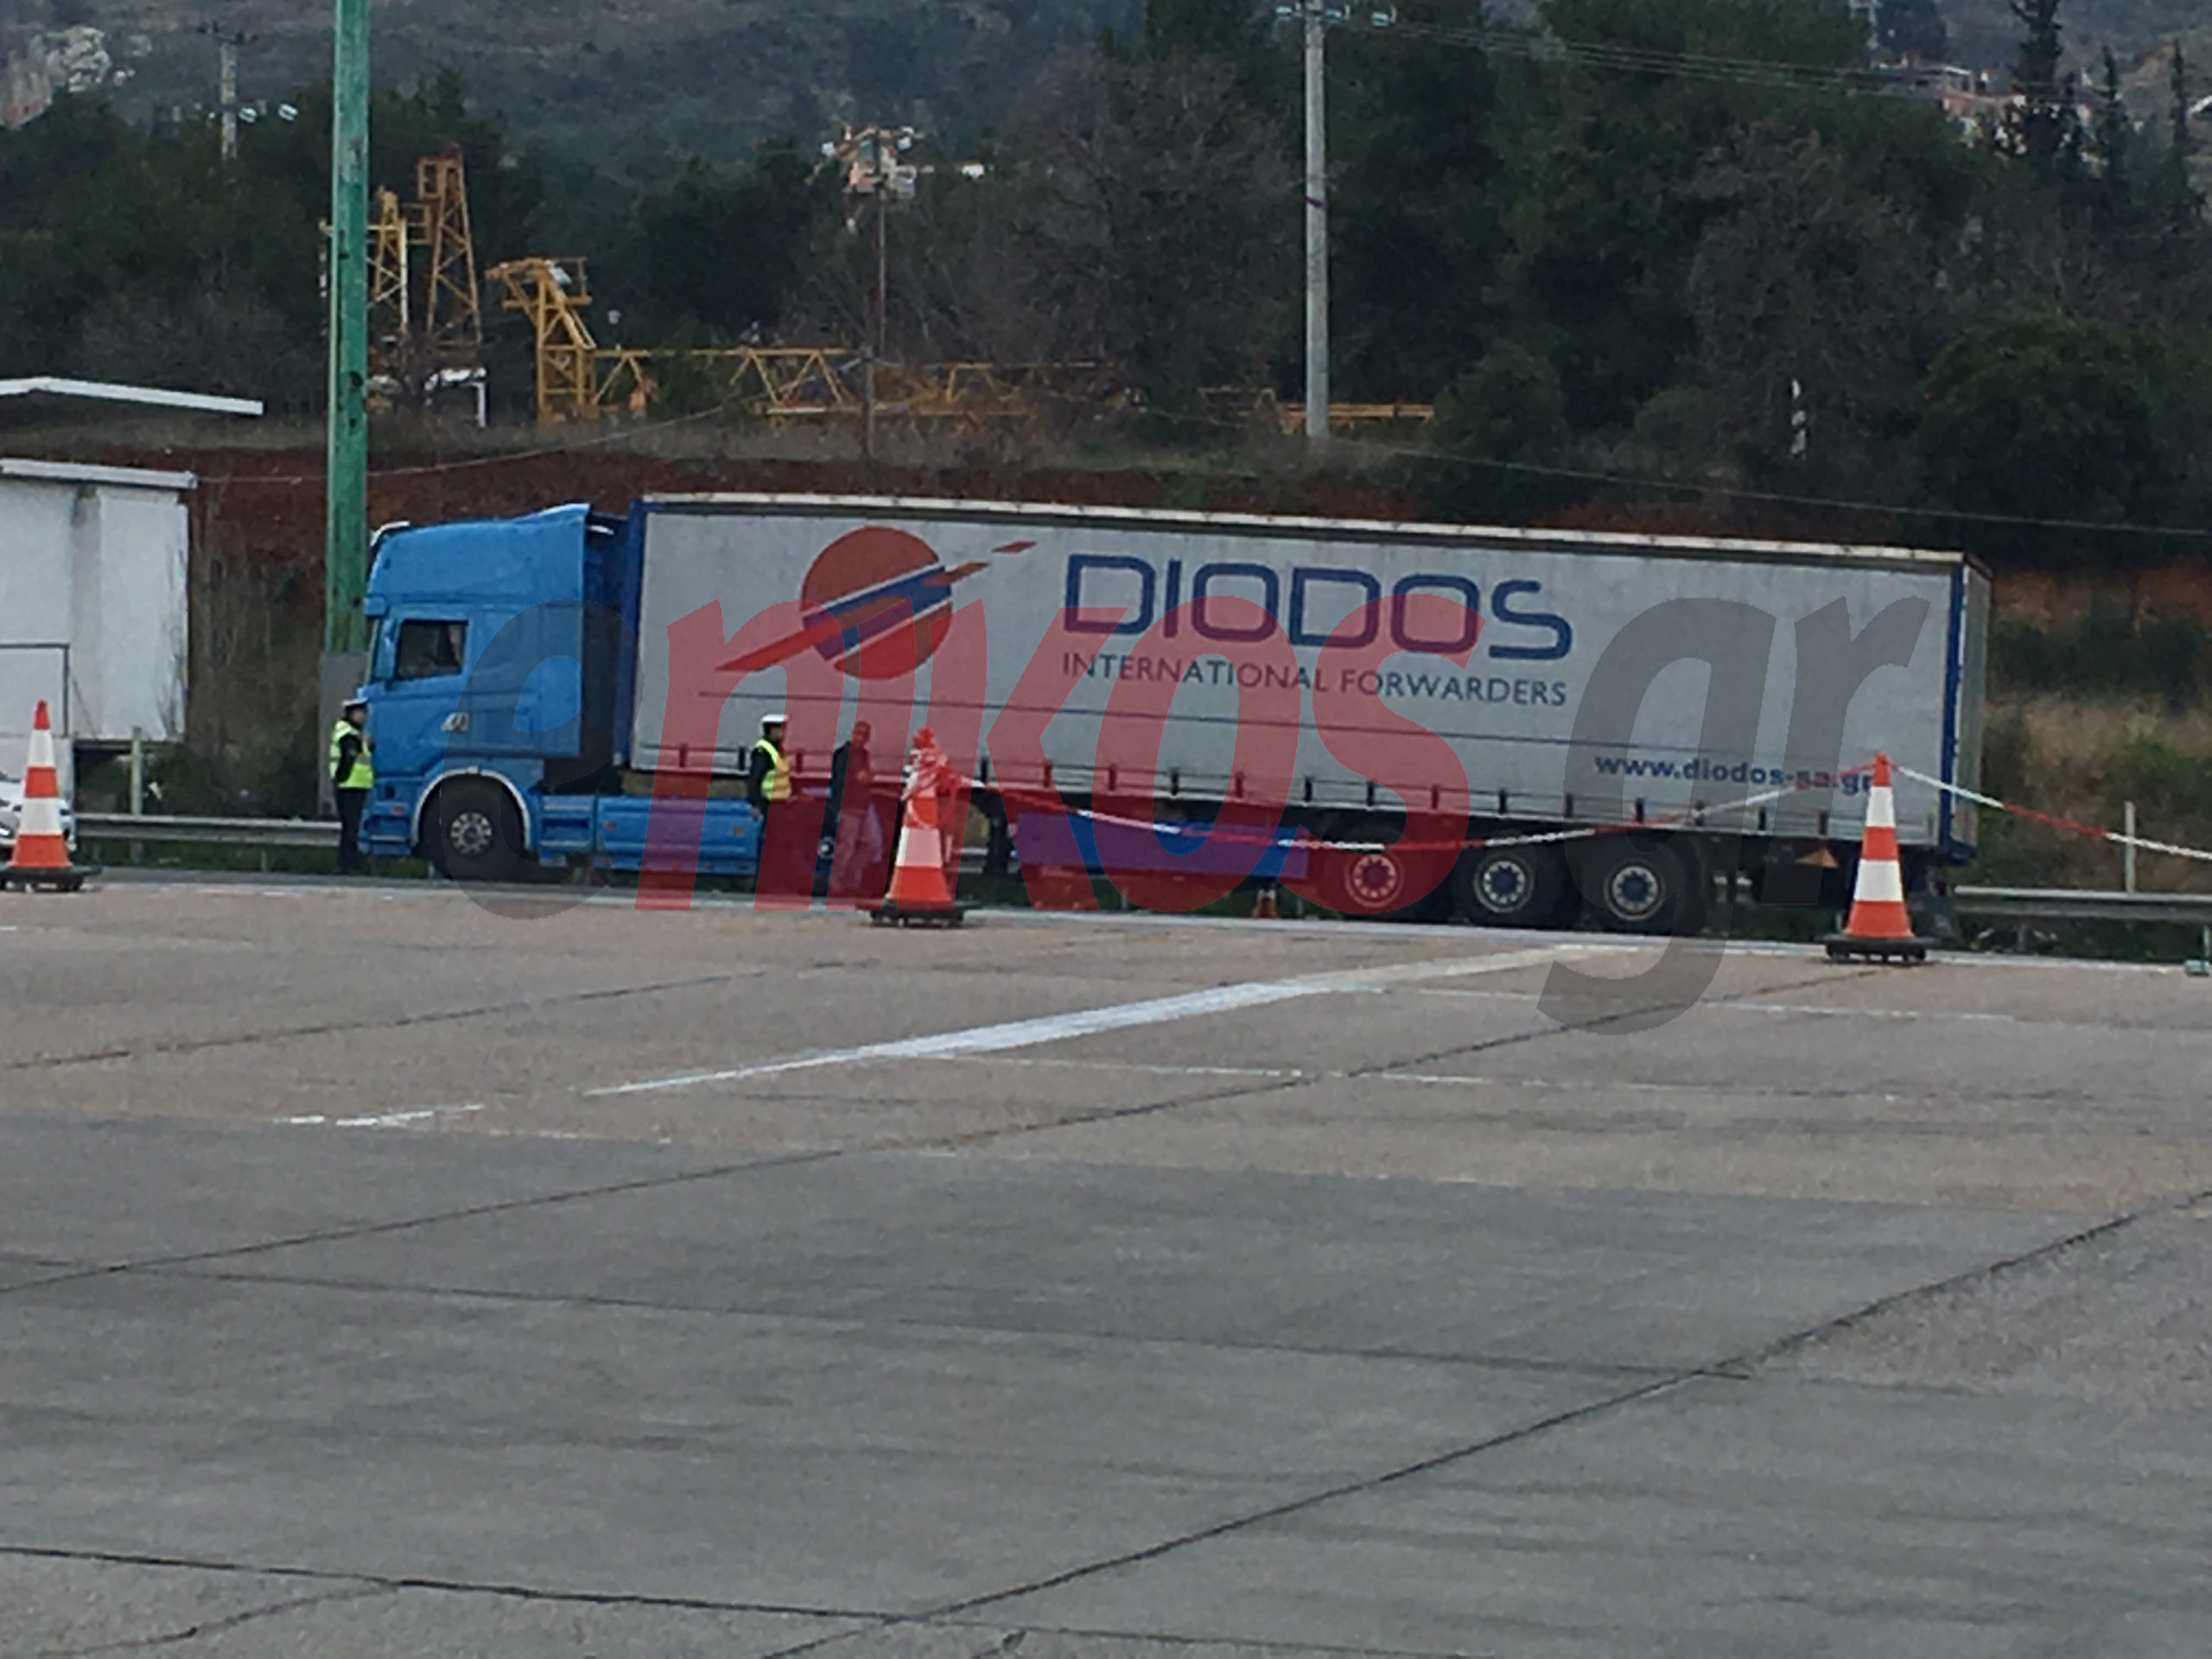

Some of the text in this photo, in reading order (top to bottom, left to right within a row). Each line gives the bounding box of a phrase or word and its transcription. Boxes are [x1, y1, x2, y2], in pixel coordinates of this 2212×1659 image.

[1063, 554, 1573, 660] DIODOS
[1064, 652, 1567, 706] INTERNATIONAL FORWARDERS
